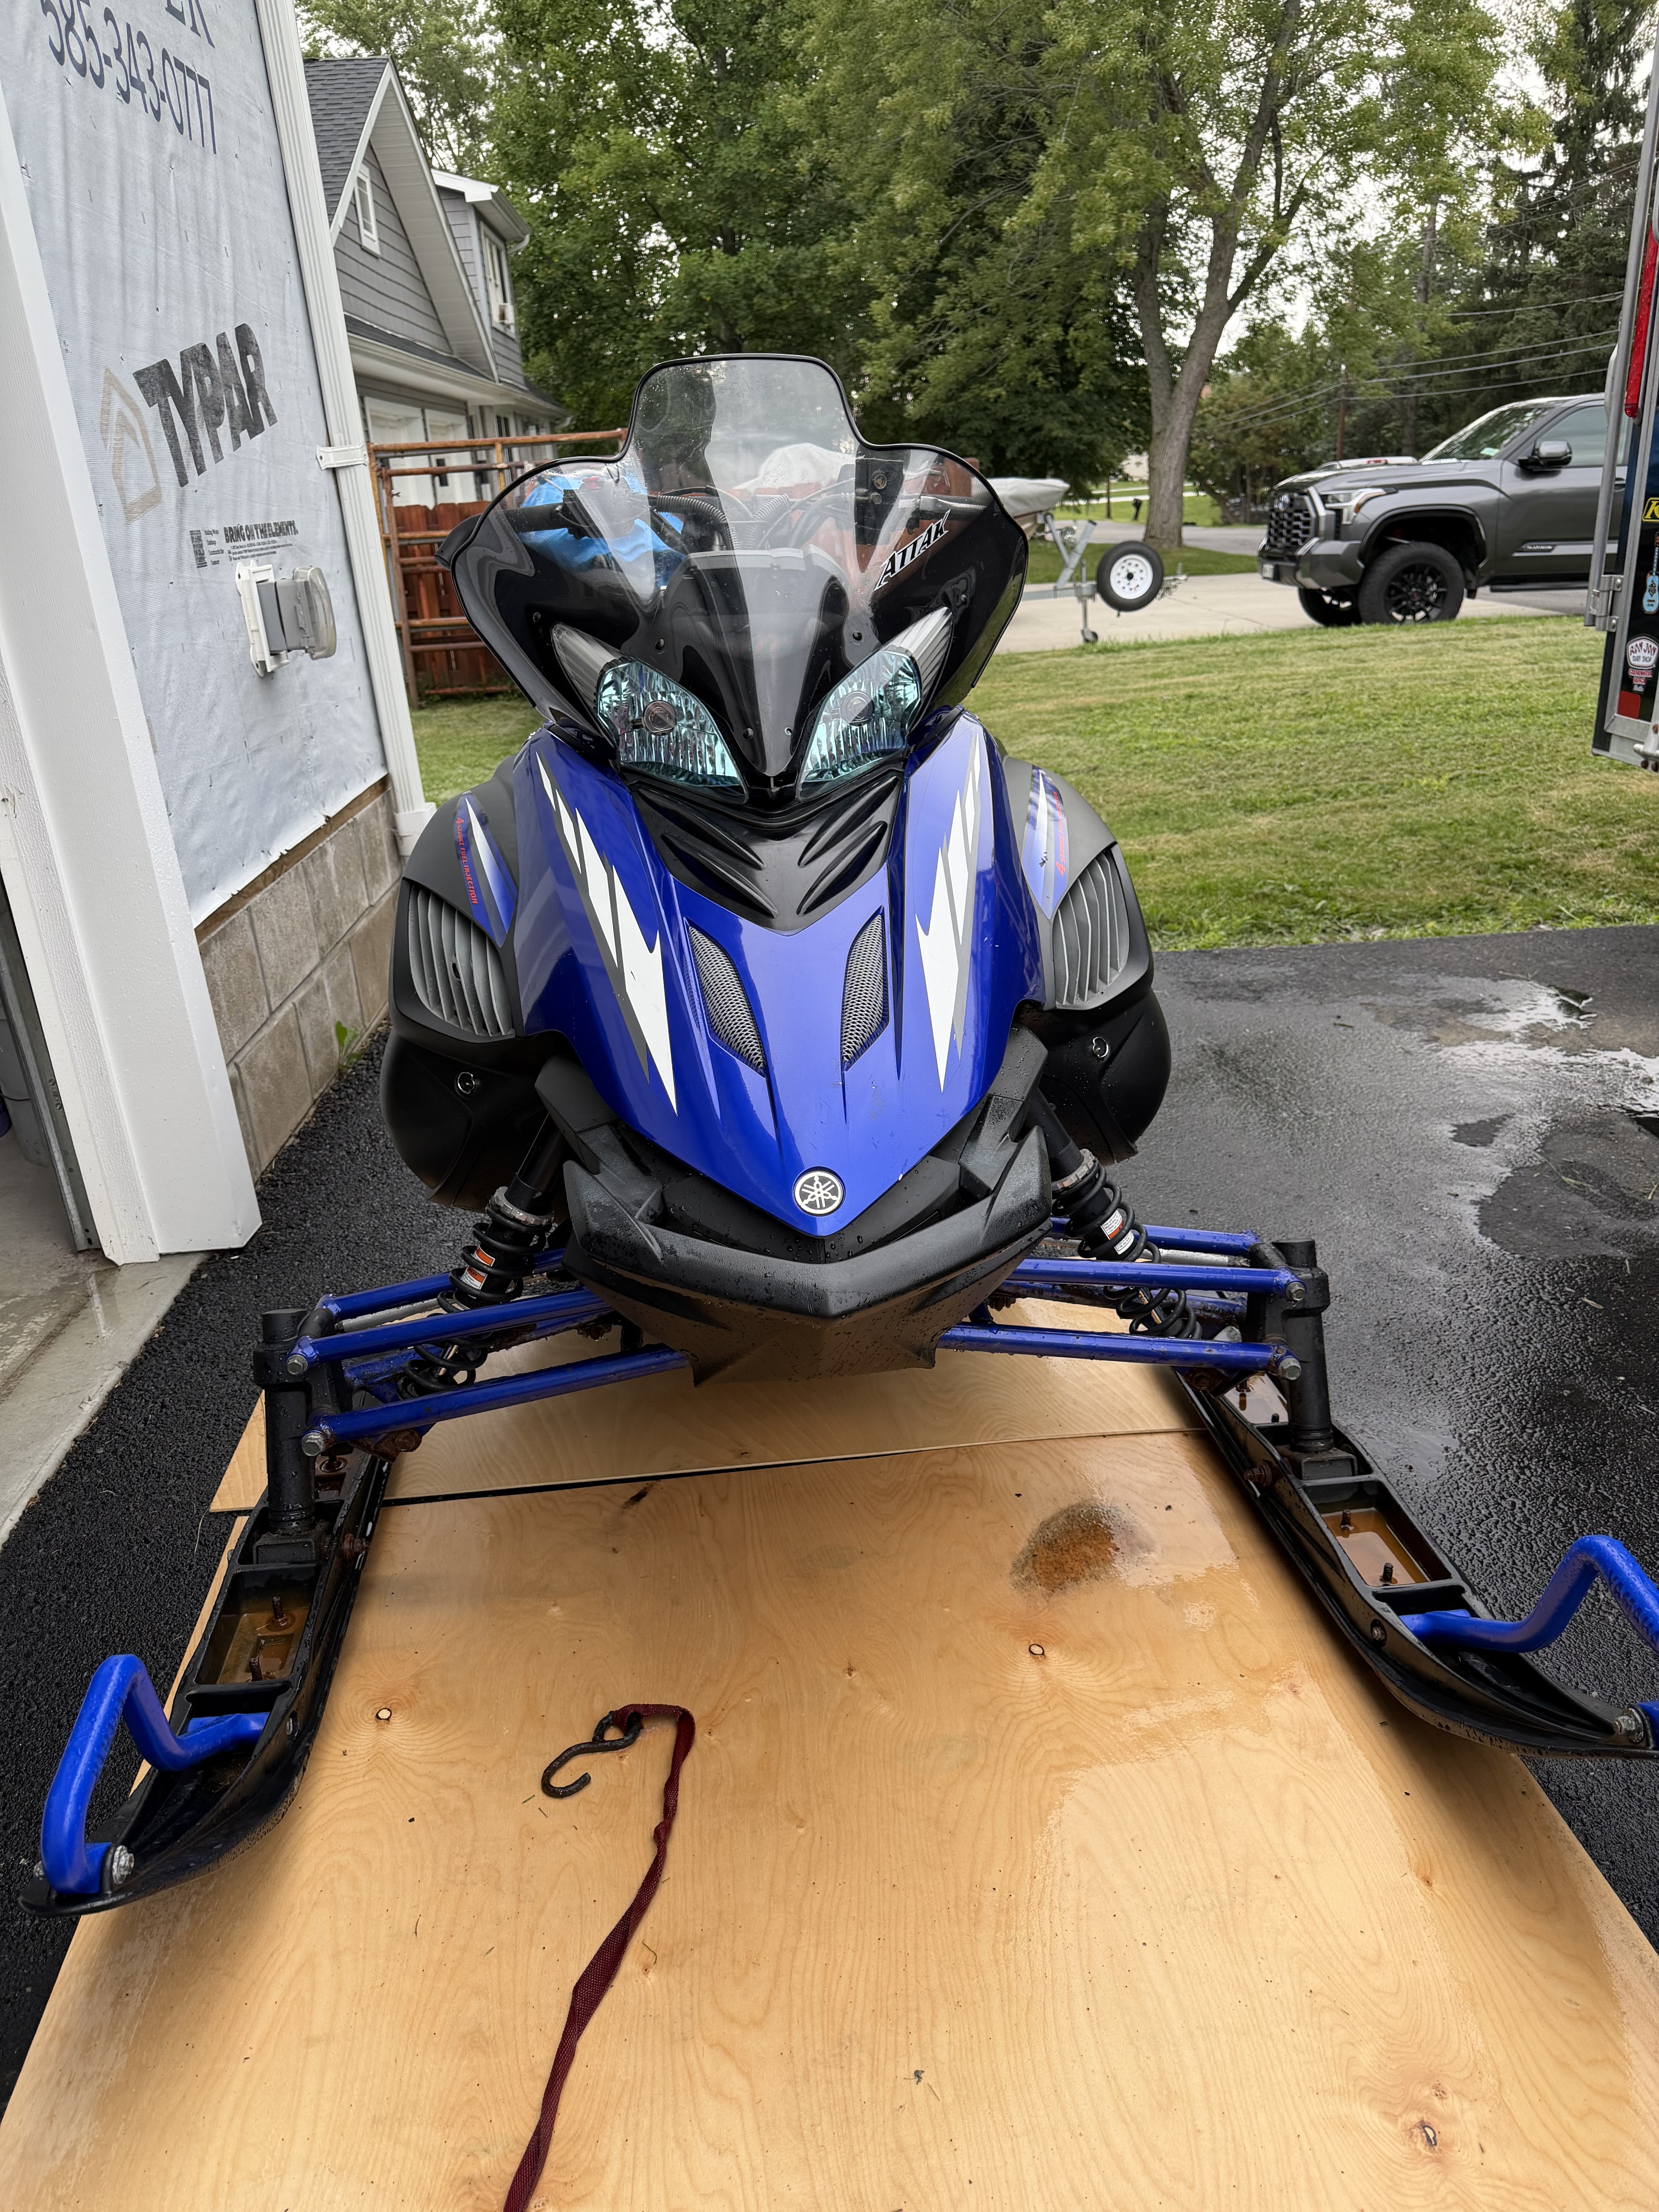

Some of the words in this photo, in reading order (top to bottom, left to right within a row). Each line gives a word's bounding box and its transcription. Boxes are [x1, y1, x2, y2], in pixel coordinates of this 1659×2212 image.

[40, 0, 217, 155] 585-343-0777
[132, 323, 278, 488] TYPAR
[223, 524, 246, 543] BRING
[245, 524, 255, 541] ON
[254, 523, 268, 539] THE
[874, 509, 951, 591] ATTAK
[1630, 642, 1643, 656] RON
[1644, 643, 1657, 656] JON
[463, 865, 478, 905] INJECTION
